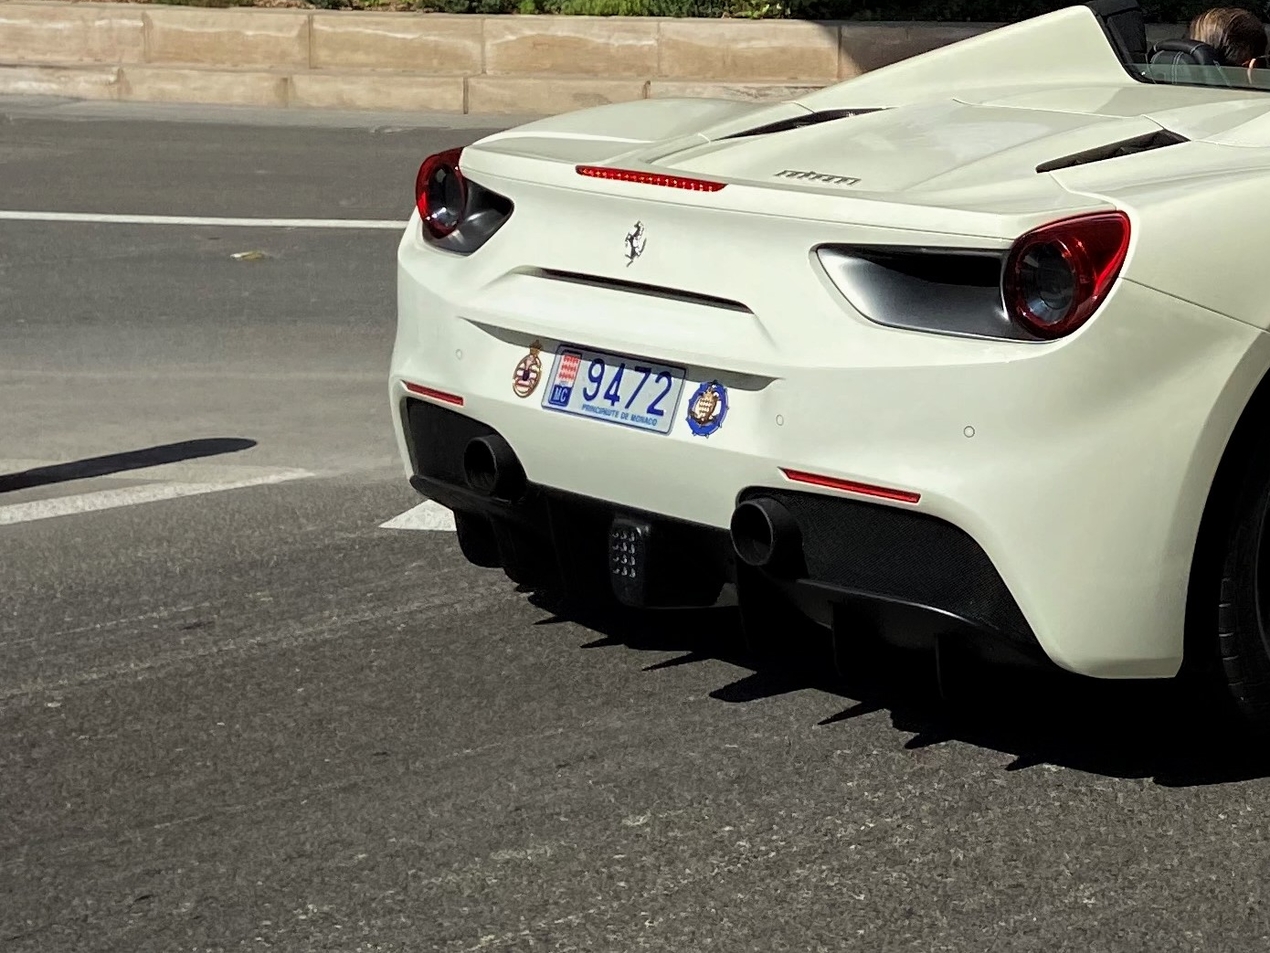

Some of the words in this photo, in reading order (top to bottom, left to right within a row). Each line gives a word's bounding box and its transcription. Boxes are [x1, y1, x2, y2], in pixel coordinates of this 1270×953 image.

[583, 358, 673, 417] 9472
[553, 388, 569, 403] MC
[620, 411, 629, 421] DE
[630, 414, 658, 426] MONACO
